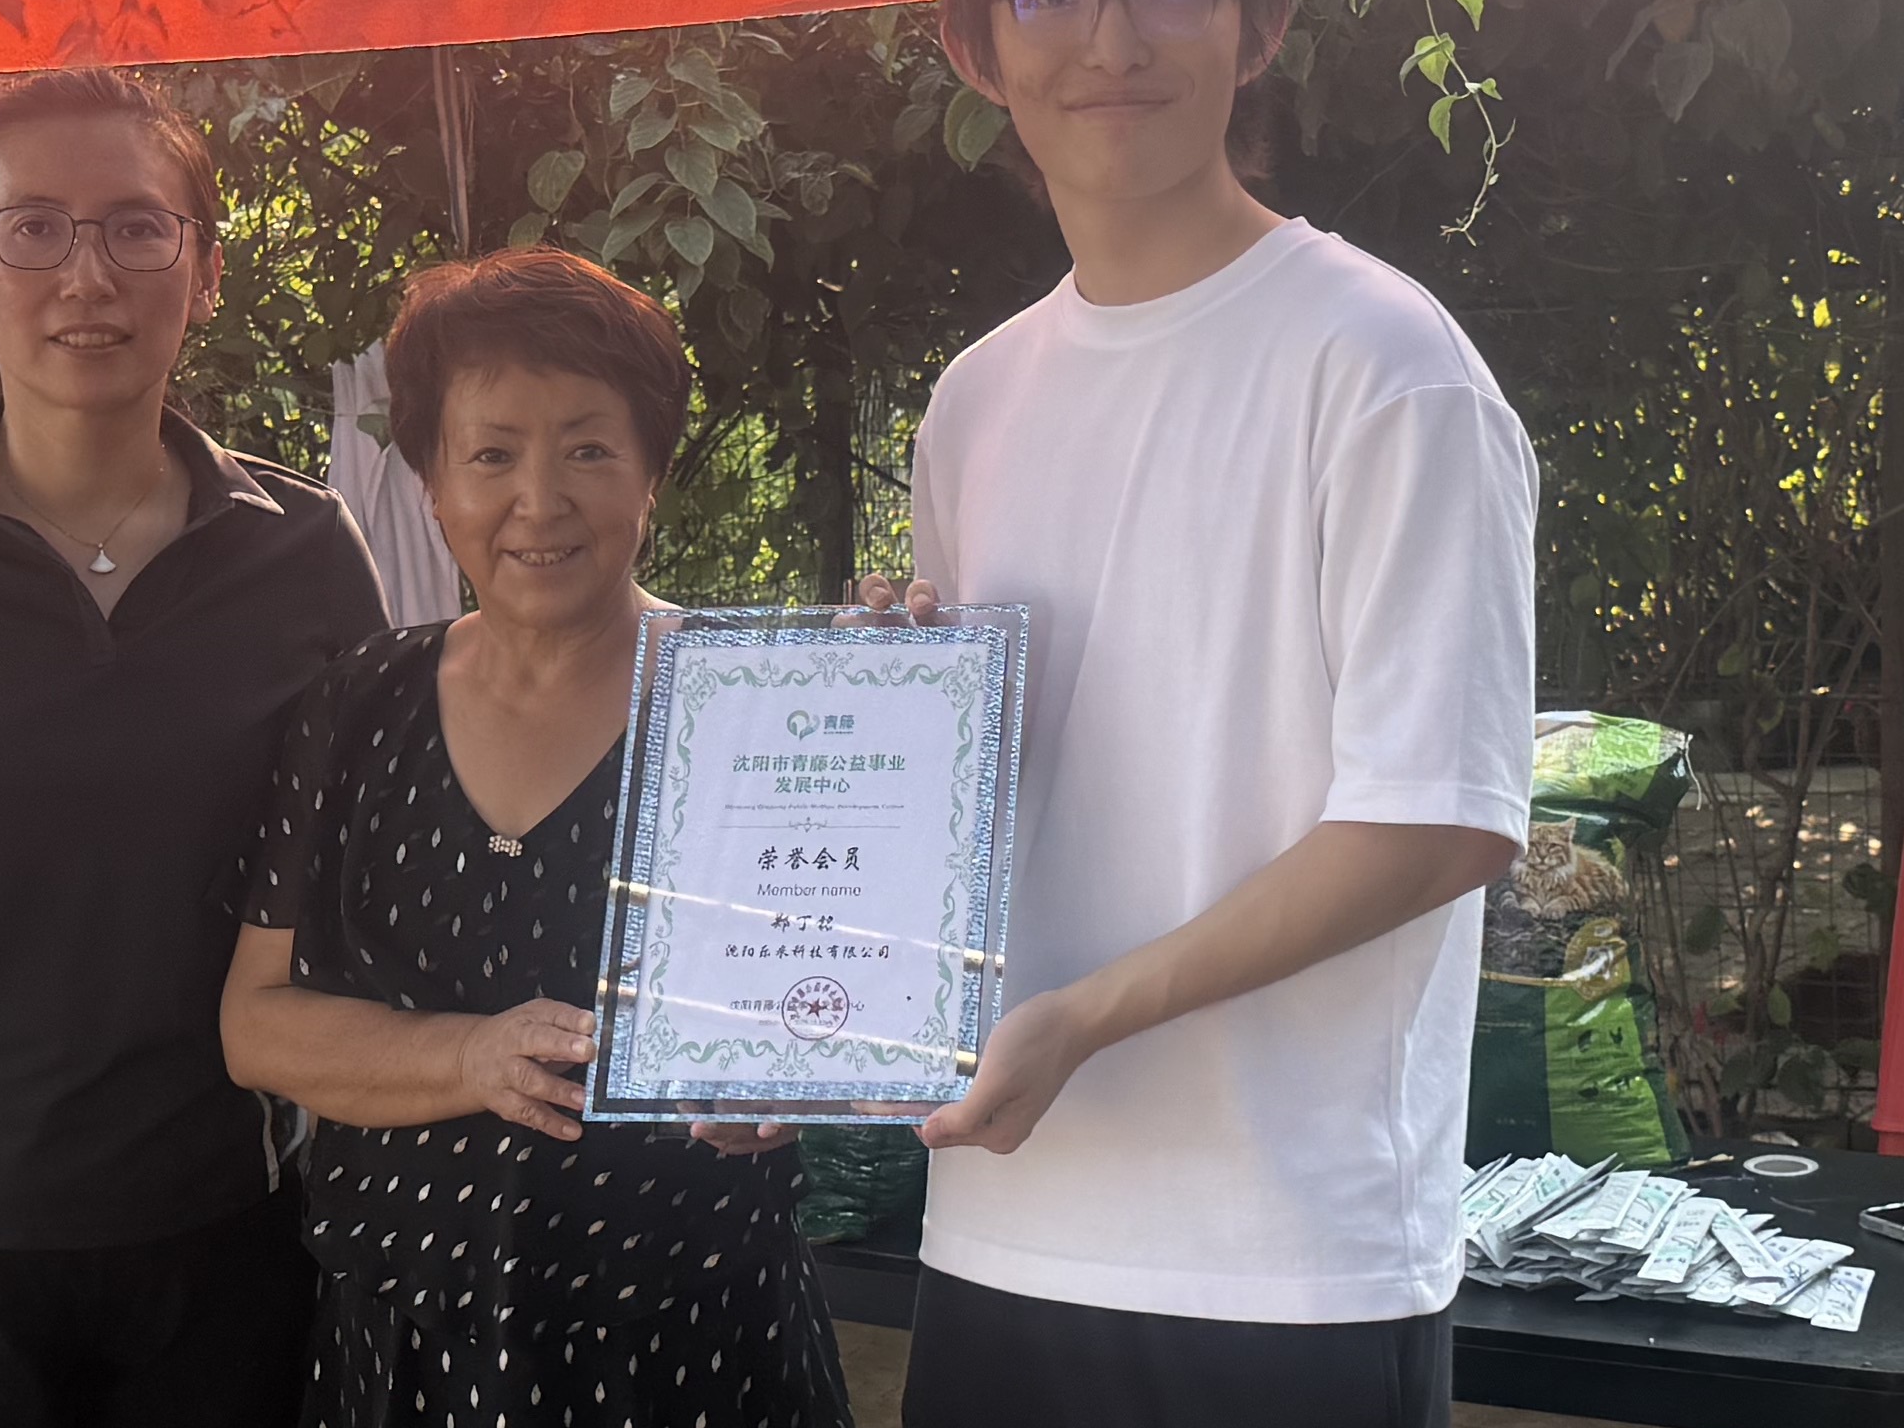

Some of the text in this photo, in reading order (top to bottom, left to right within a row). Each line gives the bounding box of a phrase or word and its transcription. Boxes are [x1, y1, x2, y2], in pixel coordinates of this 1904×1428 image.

[732, 753, 906, 773] 沈阳市青藤公益事业
[773, 775, 851, 795] 发展中心
[757, 845, 861, 872] 荣誉会员
[757, 883, 862, 897] Member name
